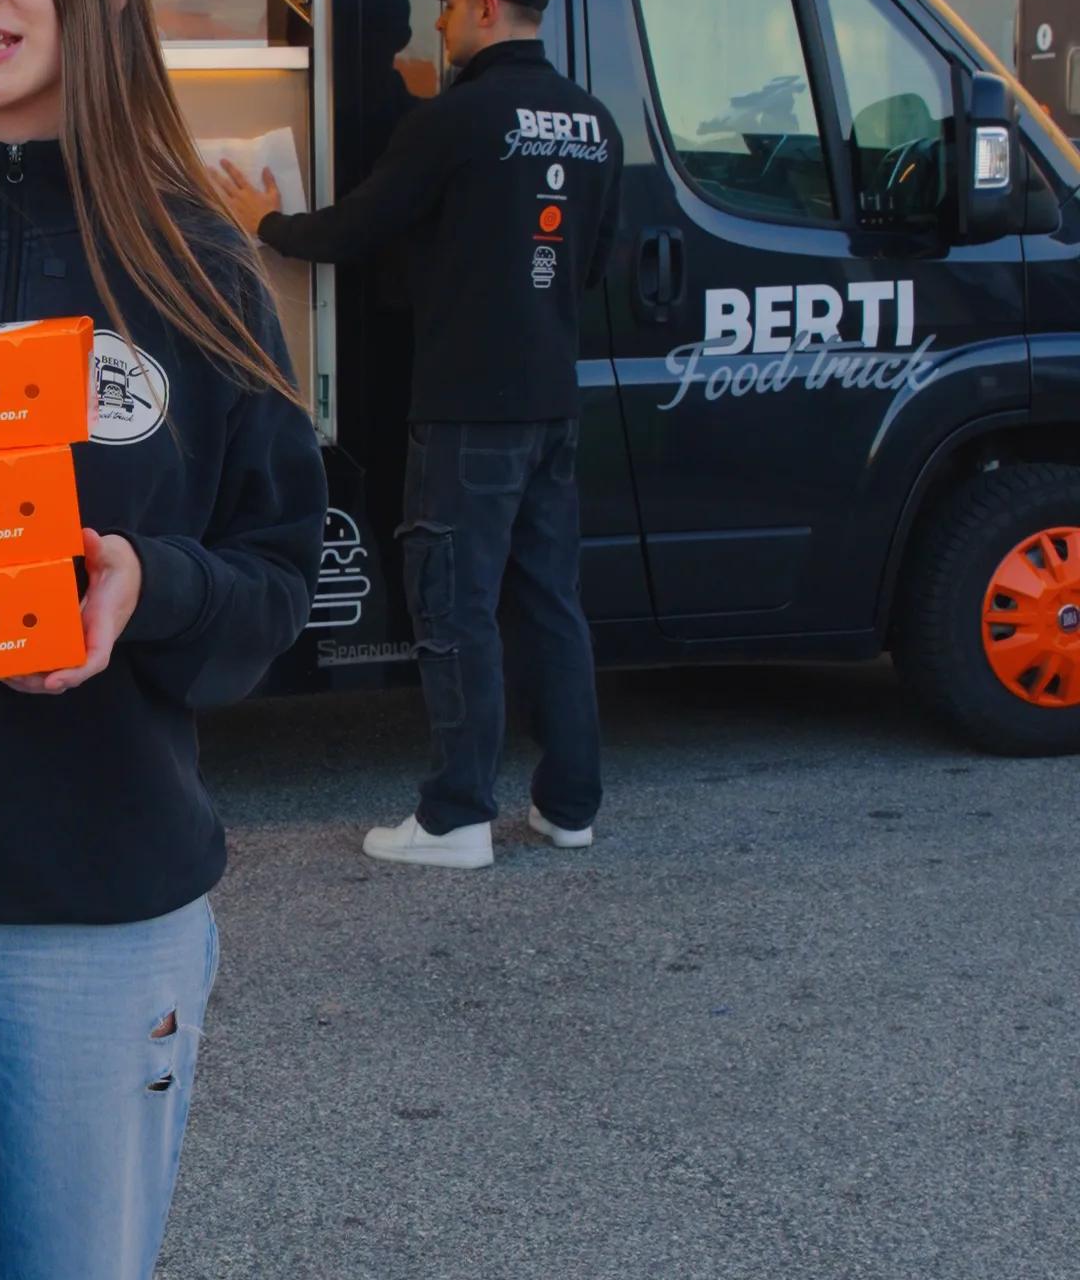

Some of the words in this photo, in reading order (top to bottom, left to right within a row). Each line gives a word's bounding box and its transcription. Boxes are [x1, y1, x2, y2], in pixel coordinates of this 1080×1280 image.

[516, 108, 601, 143] BERTI
[499, 129, 557, 160] Food
[557, 135, 609, 163] truck
[703, 280, 915, 356] BERTI
[101, 355, 128, 370] BERTI
[657, 330, 809, 410] Food
[804, 333, 940, 392] truck
